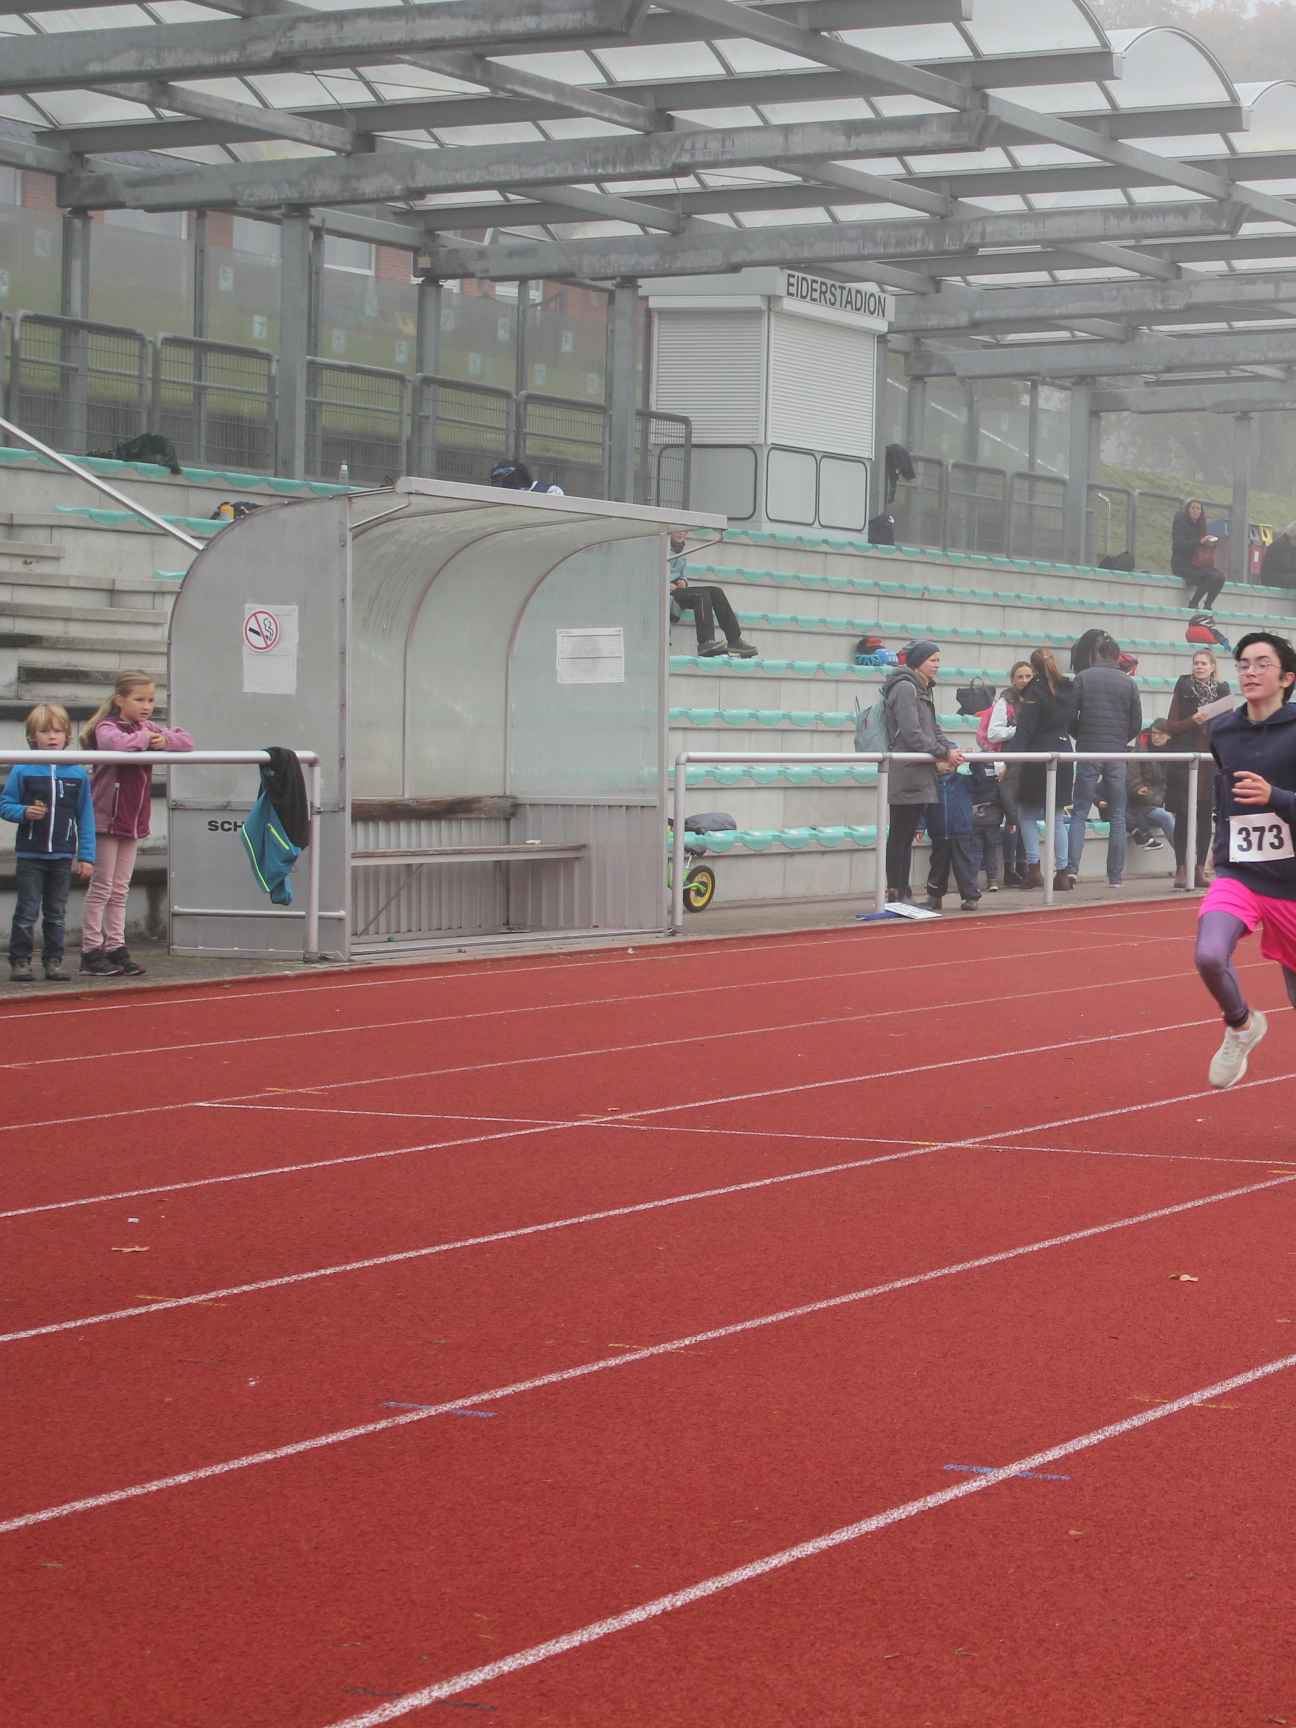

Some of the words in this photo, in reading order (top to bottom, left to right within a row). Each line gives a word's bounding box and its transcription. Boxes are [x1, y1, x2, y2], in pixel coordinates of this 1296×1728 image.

[786, 273, 886, 318] EIDERSTADION
[207, 820, 245, 832] SCH
[1237, 824, 1284, 852] 373
